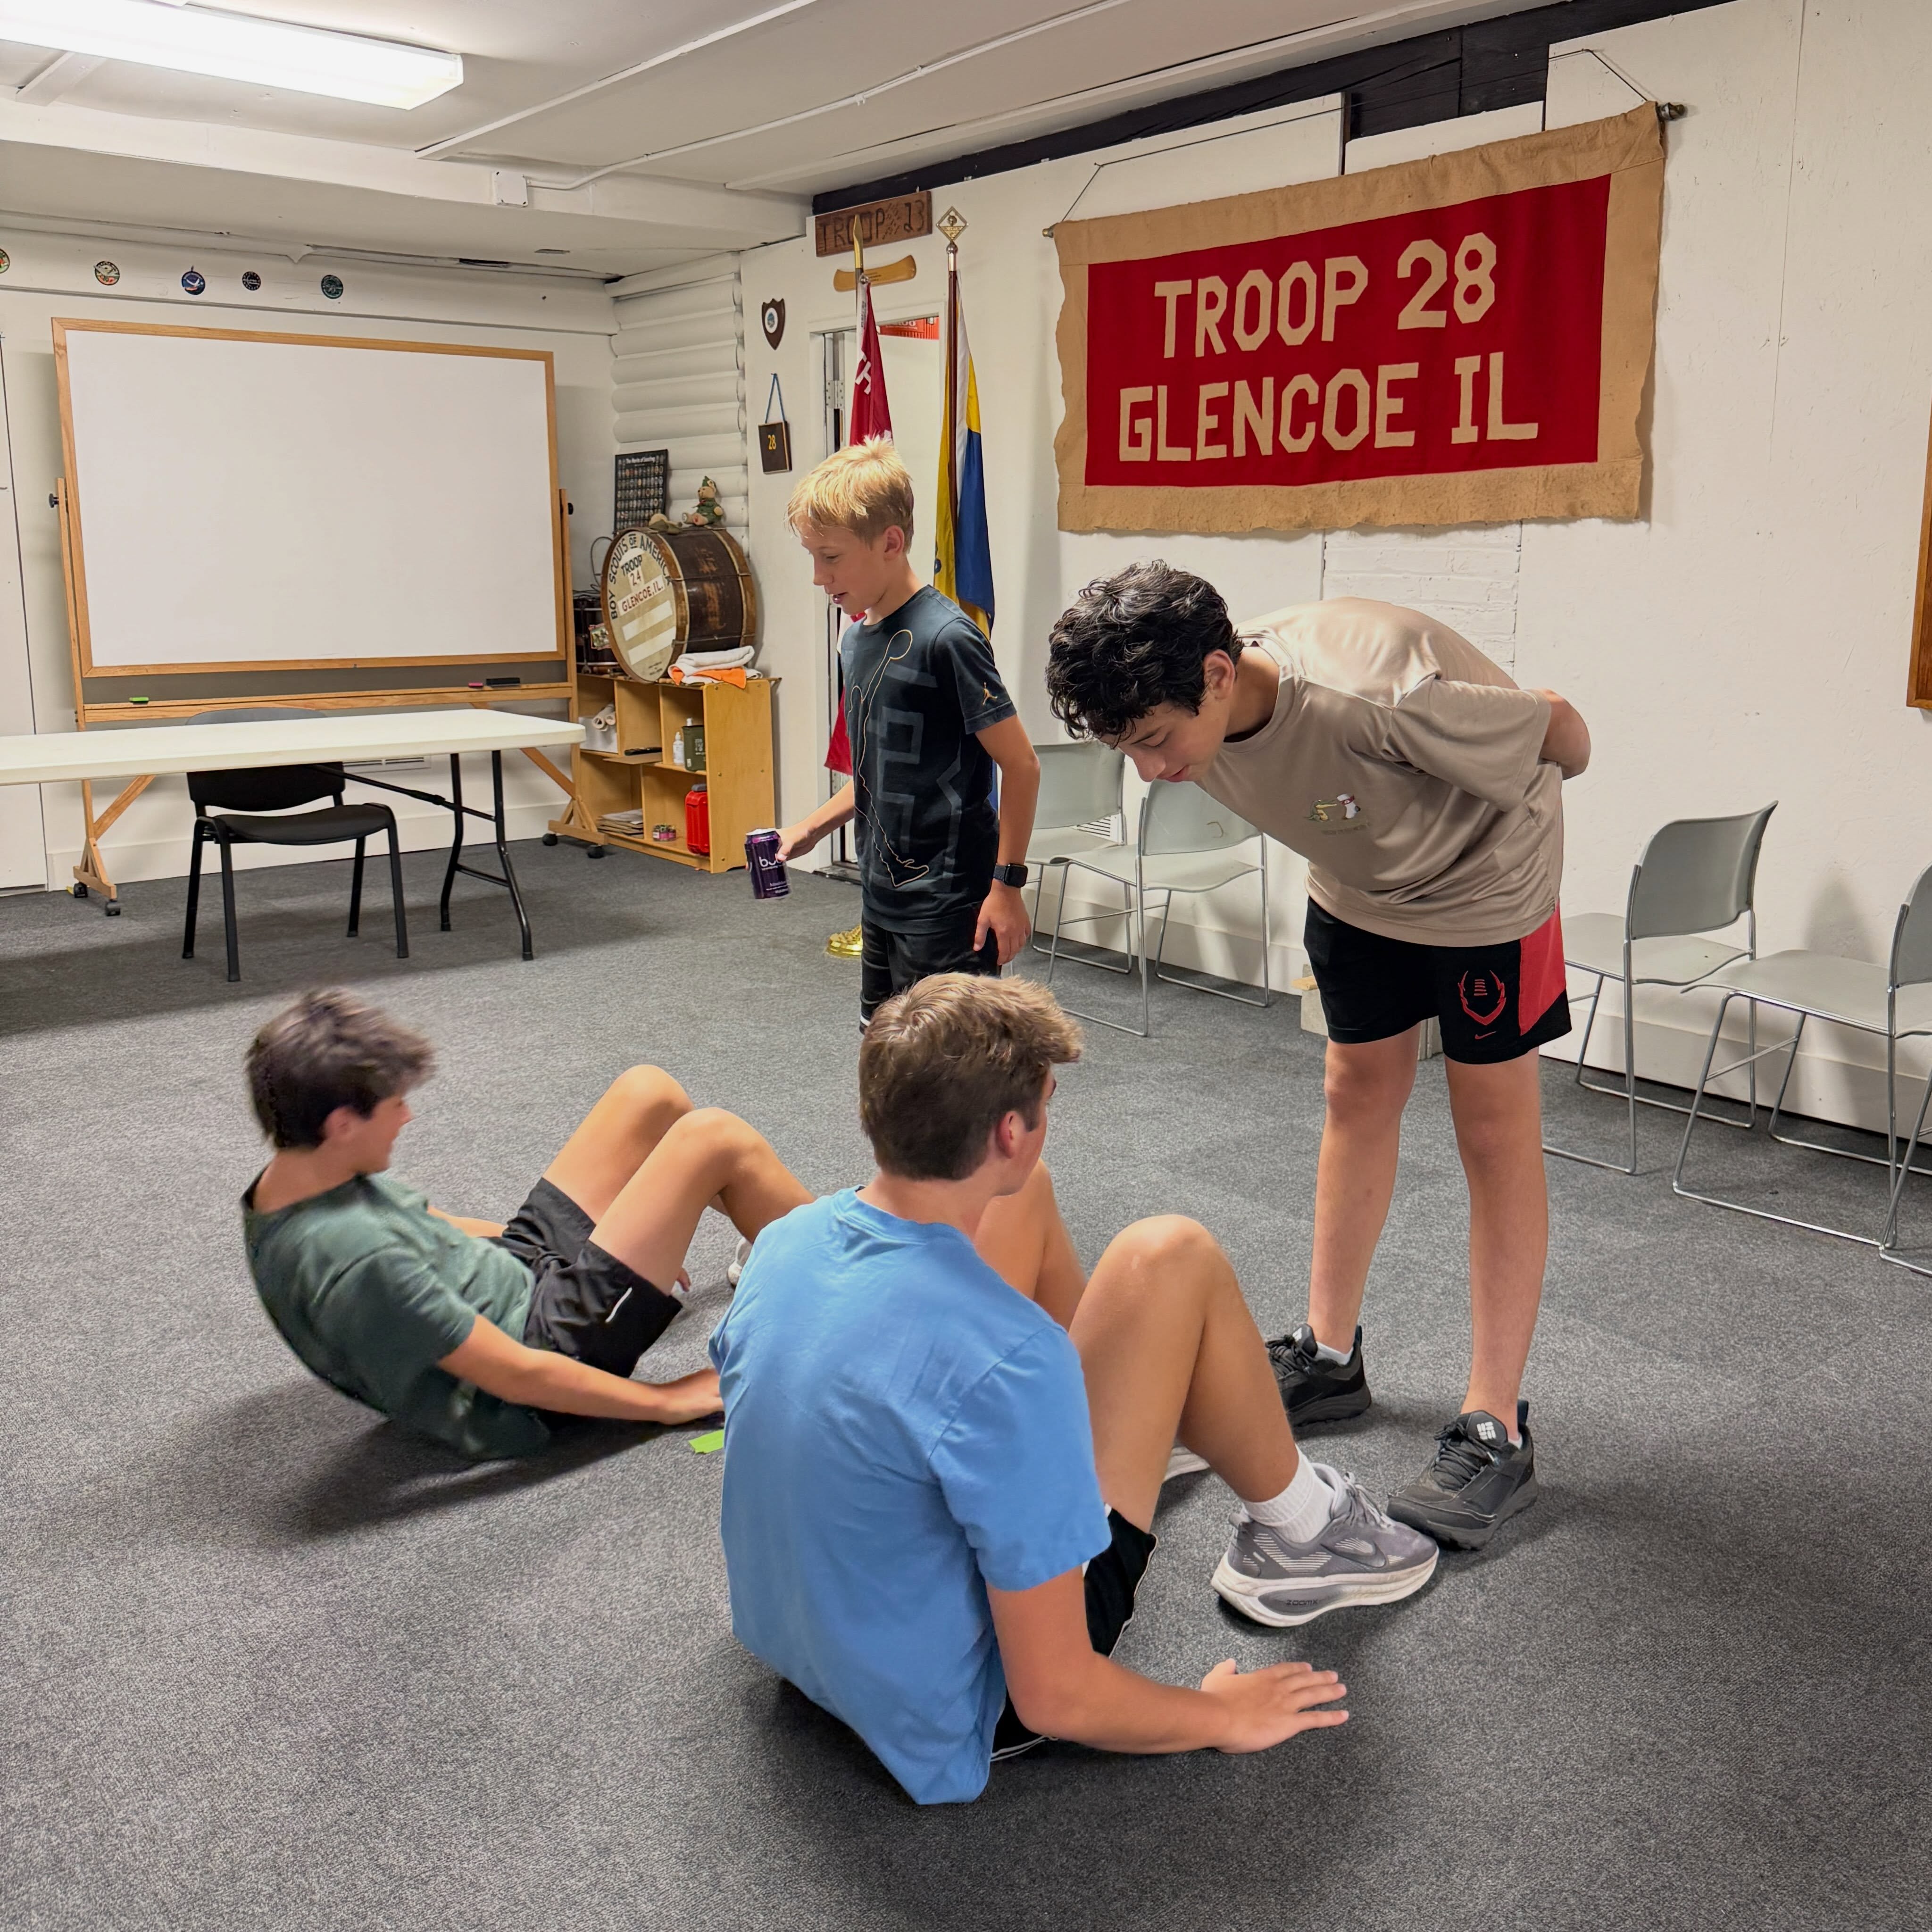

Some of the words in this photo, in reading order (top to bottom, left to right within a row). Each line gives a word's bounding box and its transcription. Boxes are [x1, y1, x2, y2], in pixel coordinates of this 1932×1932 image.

[819, 208, 885, 252] TROOP
[1154, 255, 1369, 358] TROOP
[1397, 232, 1497, 330] 28
[1118, 361, 1419, 462] GLENCOE
[1451, 351, 1539, 444] IL
[768, 434, 776, 450] 28
[629, 536, 637, 546] OF
[608, 538, 628, 585] SCOUTS
[621, 554, 642, 576] TROOP
[630, 569, 642, 587] 24
[640, 535, 672, 586] AMERICA
[608, 589, 618, 620] BOY
